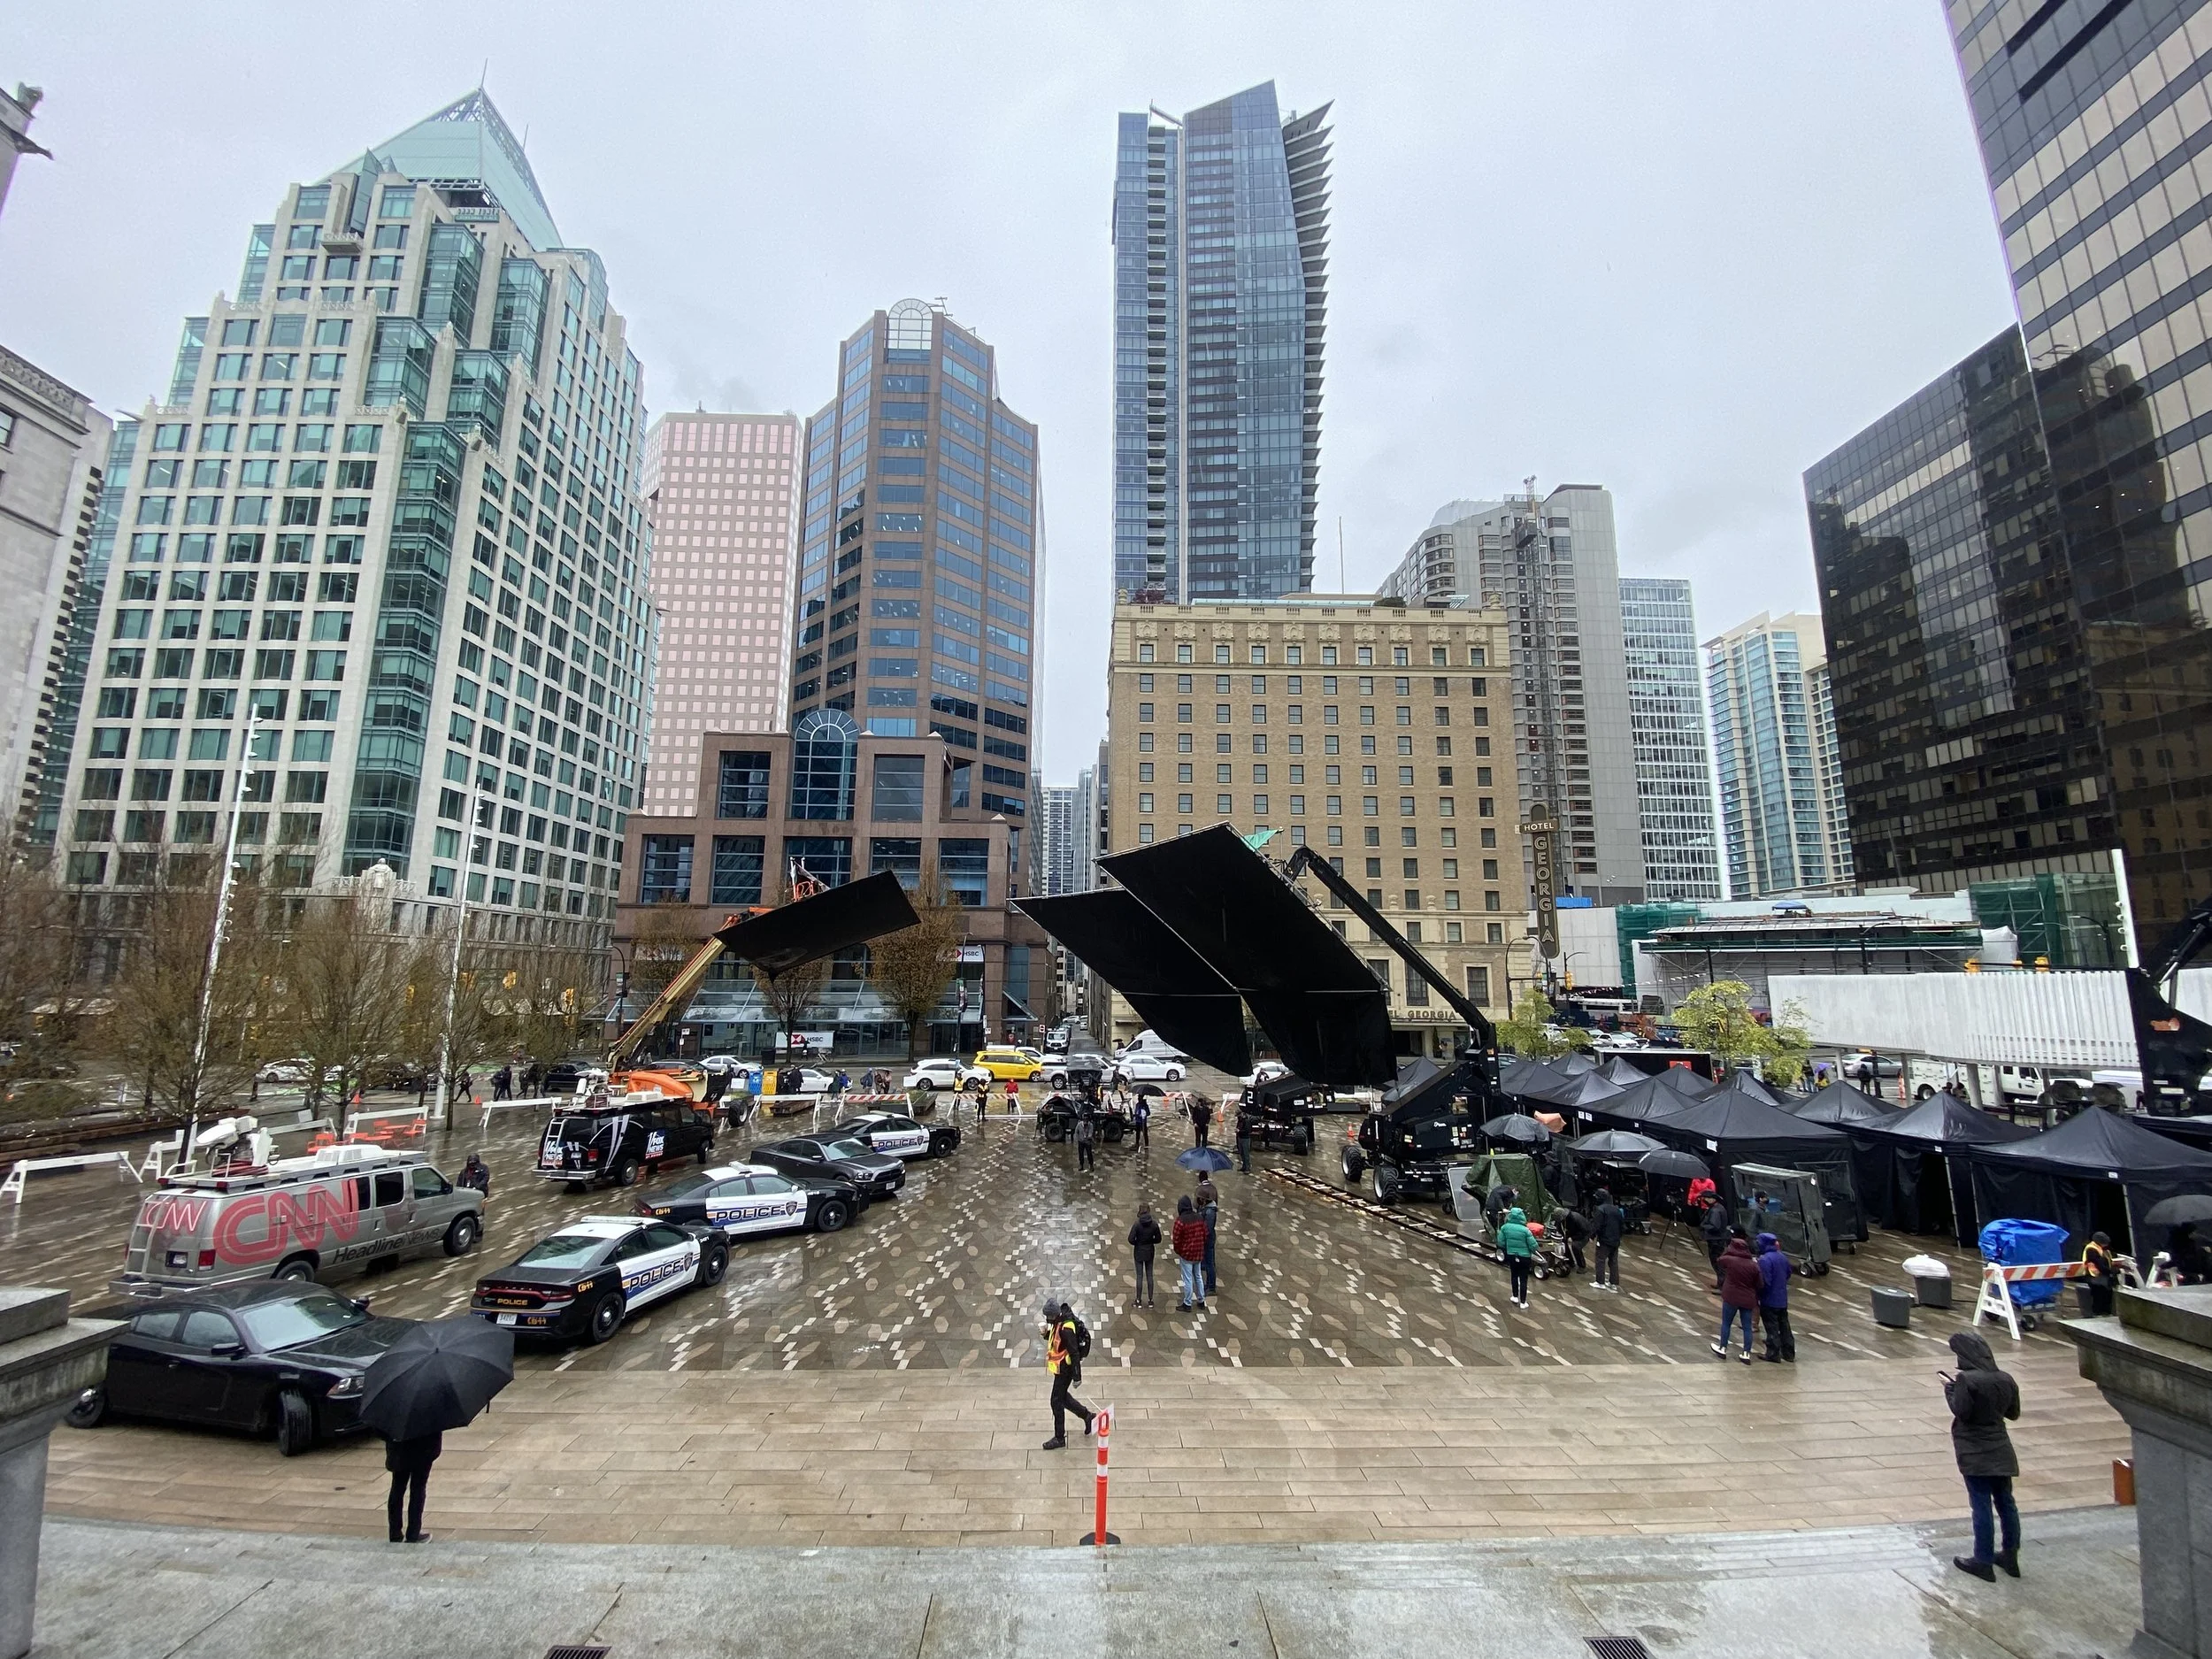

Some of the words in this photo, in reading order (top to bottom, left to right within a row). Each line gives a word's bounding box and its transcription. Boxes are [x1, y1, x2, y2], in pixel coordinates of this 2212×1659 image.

[1524, 822, 1555, 832] HOTEL
[1533, 836, 1555, 942] GEORGIA
[1408, 1010, 1456, 1019] GEORGIA
[1247, 1091, 1254, 1104] 2
[649, 1144, 664, 1153] NEWS
[878, 1138, 915, 1149] POLICE
[142, 1197, 209, 1235] CNN
[213, 1179, 359, 1265] CNN
[716, 1206, 783, 1222] POLICE
[333, 1238, 403, 1264] Headline
[403, 1229, 440, 1246] News
[629, 1260, 682, 1291] POLICE
